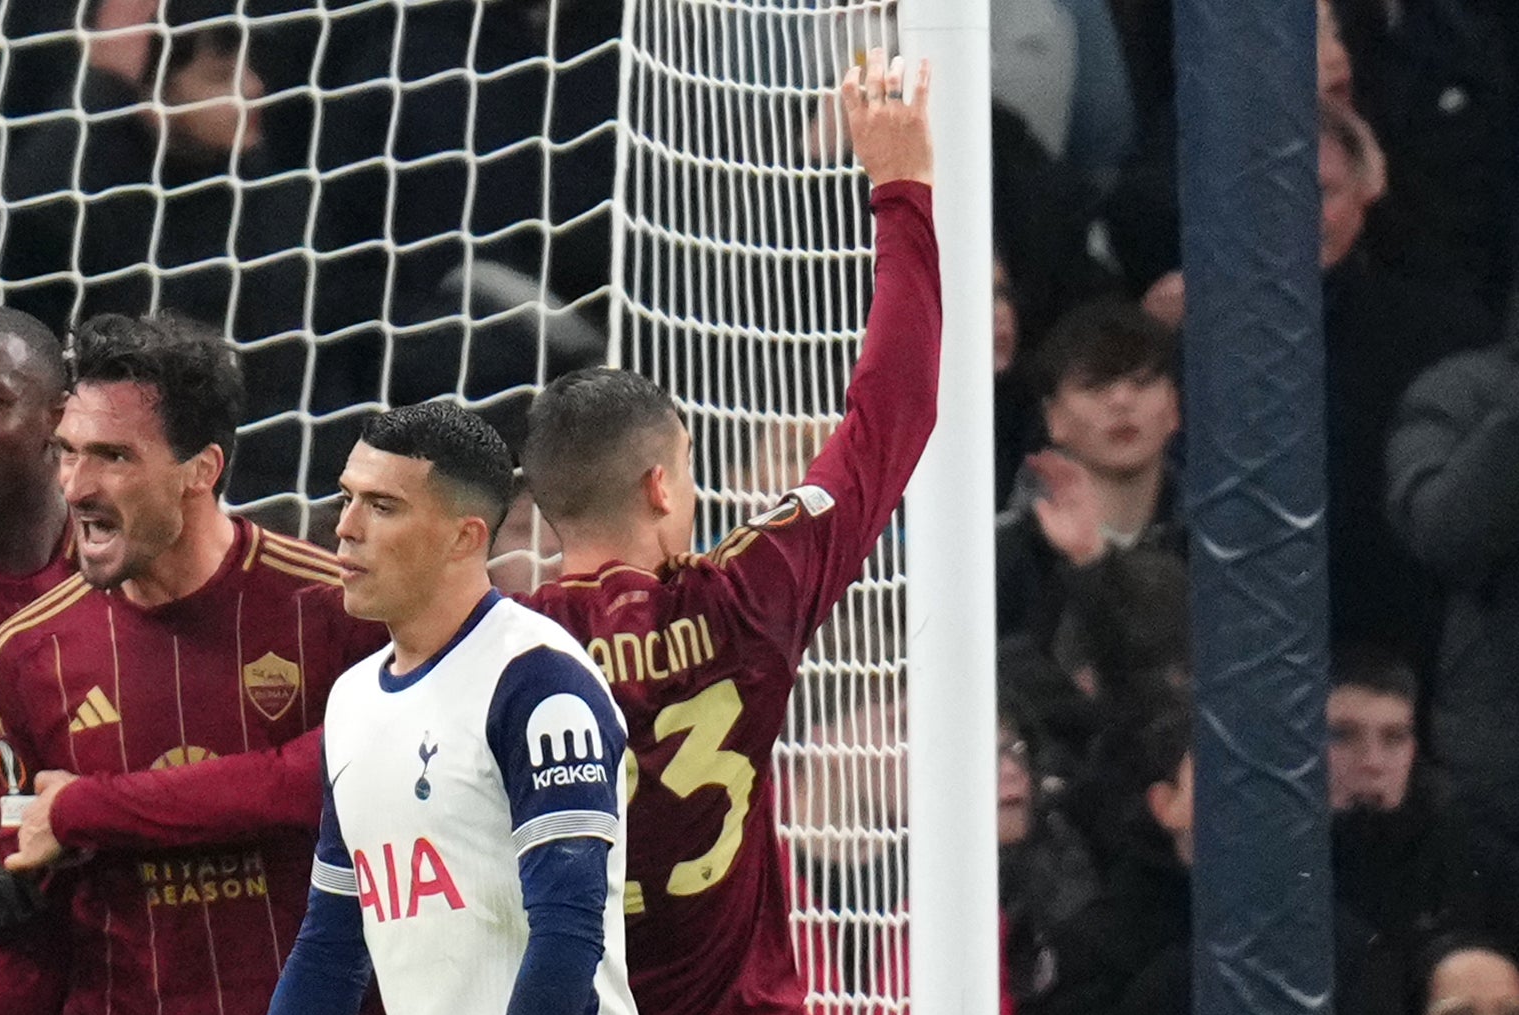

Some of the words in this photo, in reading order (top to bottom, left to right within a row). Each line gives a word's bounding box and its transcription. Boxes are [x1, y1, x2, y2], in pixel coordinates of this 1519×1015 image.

[587, 613, 715, 683] ANCINI
[532, 762, 608, 790] kraken
[353, 837, 466, 923] AIA
